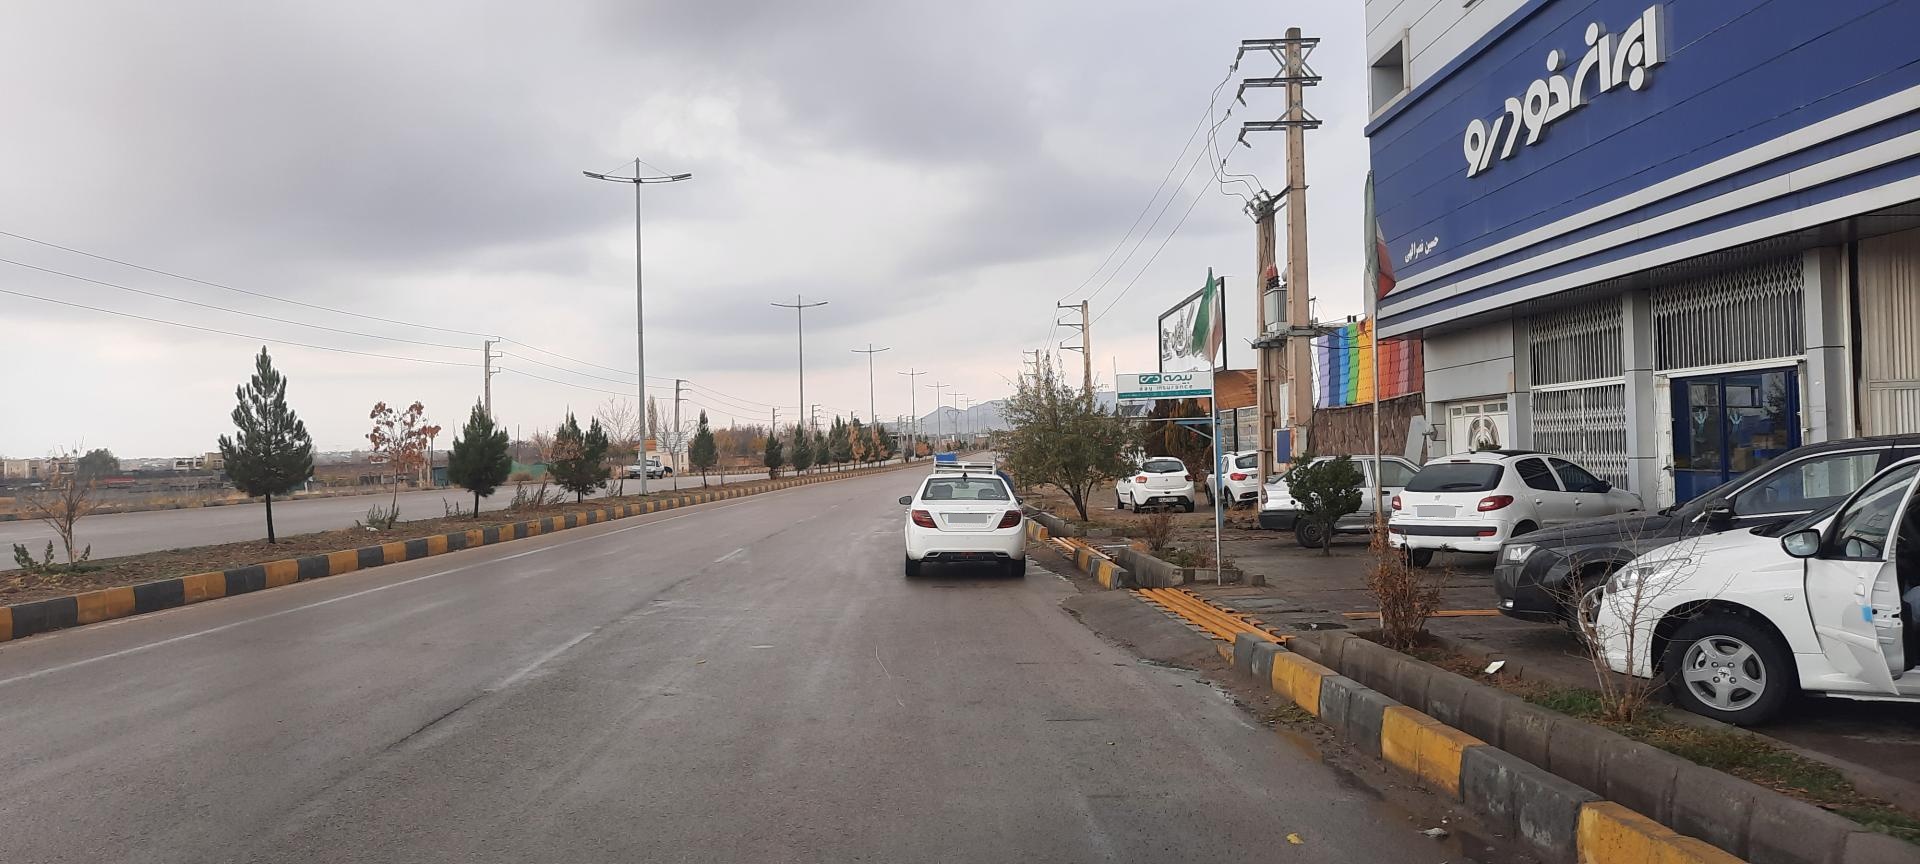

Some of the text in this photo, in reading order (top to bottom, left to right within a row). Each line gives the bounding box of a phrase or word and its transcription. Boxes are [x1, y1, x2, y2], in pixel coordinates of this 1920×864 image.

[1464, 4, 1665, 178] ایران خودرو
[1424, 236, 1439, 255] حسین
[1163, 374, 1193, 385] بیمه
